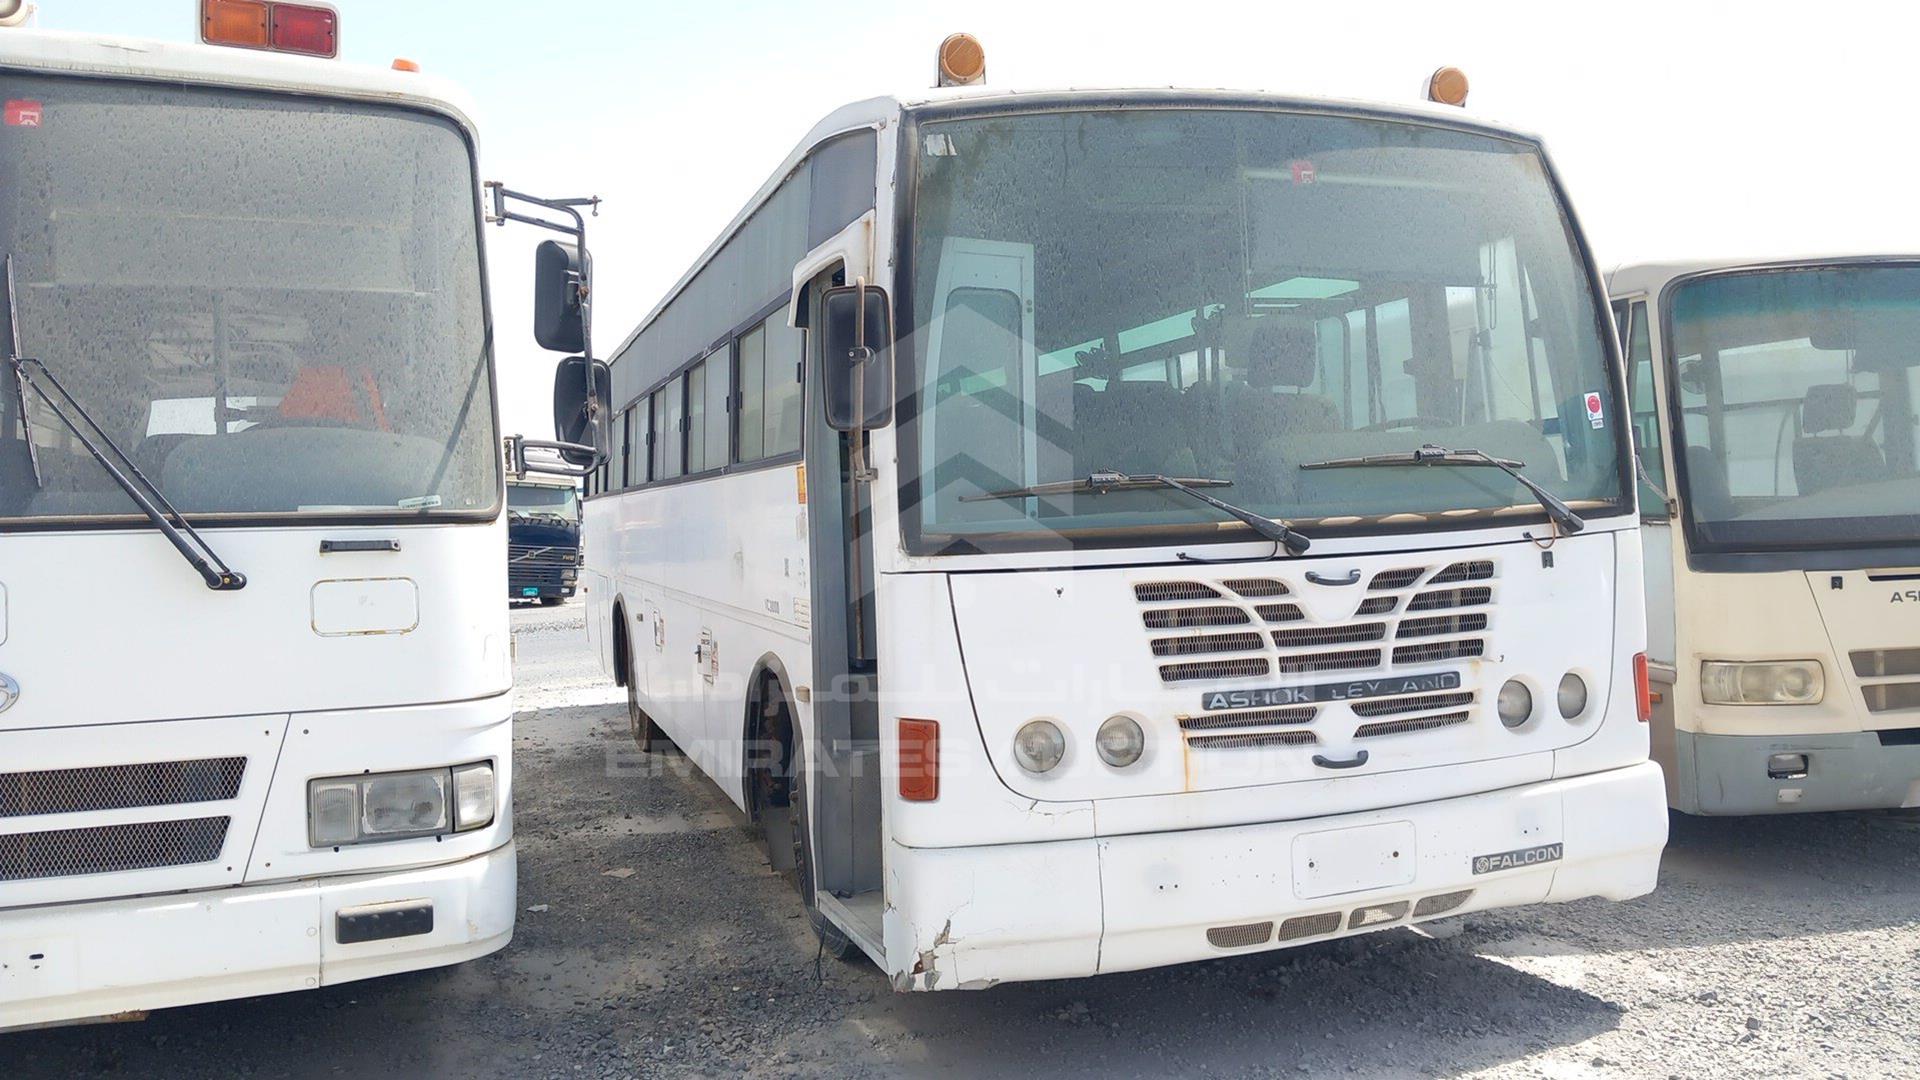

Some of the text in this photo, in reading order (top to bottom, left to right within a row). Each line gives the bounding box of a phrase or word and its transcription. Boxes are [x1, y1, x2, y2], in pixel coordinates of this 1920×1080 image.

[1890, 590, 1920, 603] AS
[1209, 688, 1311, 709] ASHOK
[1489, 846, 1560, 870] FALCON
